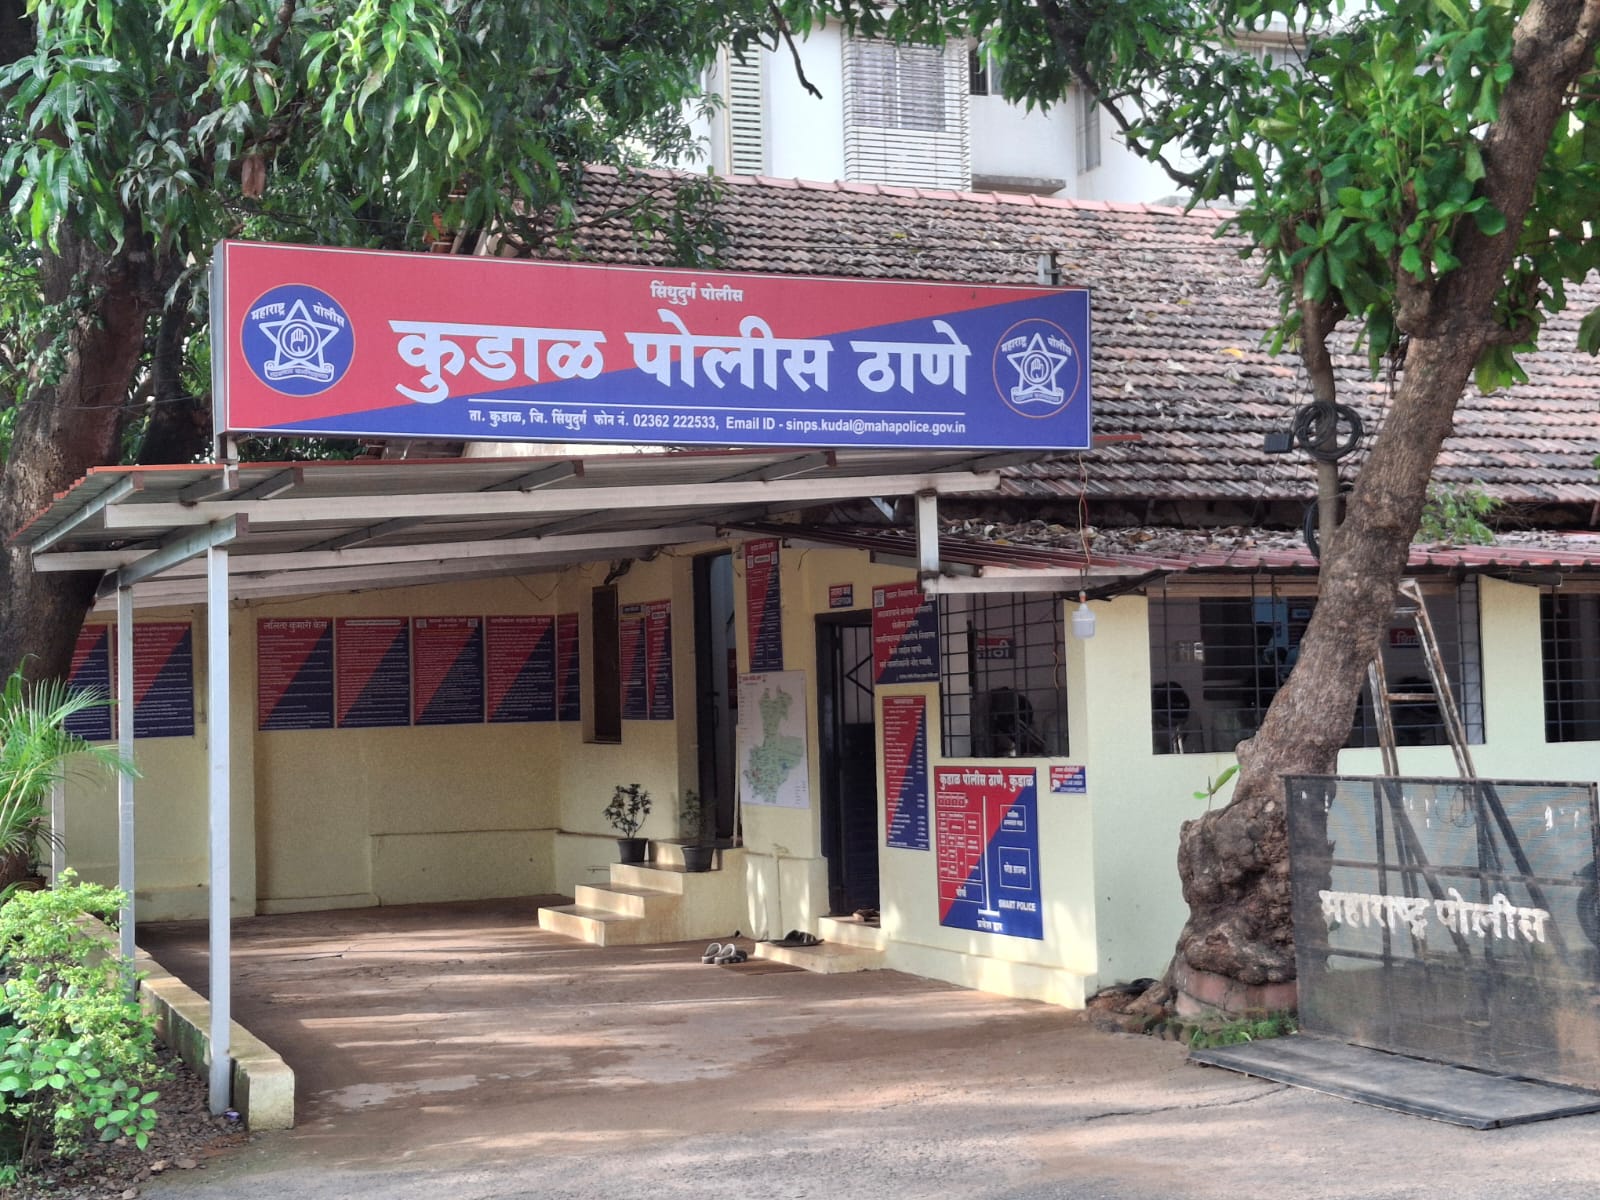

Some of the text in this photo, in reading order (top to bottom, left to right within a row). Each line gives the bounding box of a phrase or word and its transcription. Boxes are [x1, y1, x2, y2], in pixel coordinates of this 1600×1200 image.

[699, 283, 744, 302] पोलीस
[251, 302, 345, 328] महाराष्ट्र पोलीस
[388, 308, 973, 404] कुडाळ पोलीस ठाणे
[1001, 334, 1072, 357] महाराष्ट्र पोलीस
[468, 410, 486, 422] ता.
[489, 410, 526, 428] कुडाळ,
[529, 407, 548, 424] जि.
[593, 410, 615, 426] फोन
[617, 411, 629, 426] नं.
[633, 413, 670, 428] 02362
[672, 414, 720, 431] 222533,
[726, 416, 760, 430] Email
[762, 417, 775, 430] ID
[785, 418, 966, 434] sinps.kudal@mahapolice.gov.in
[962, 769, 986, 786] पोलीस
[1008, 774, 1034, 792] कुडाळ
[1016, 901, 1036, 912] POLICE
[1434, 887, 1550, 943] पोलीस
